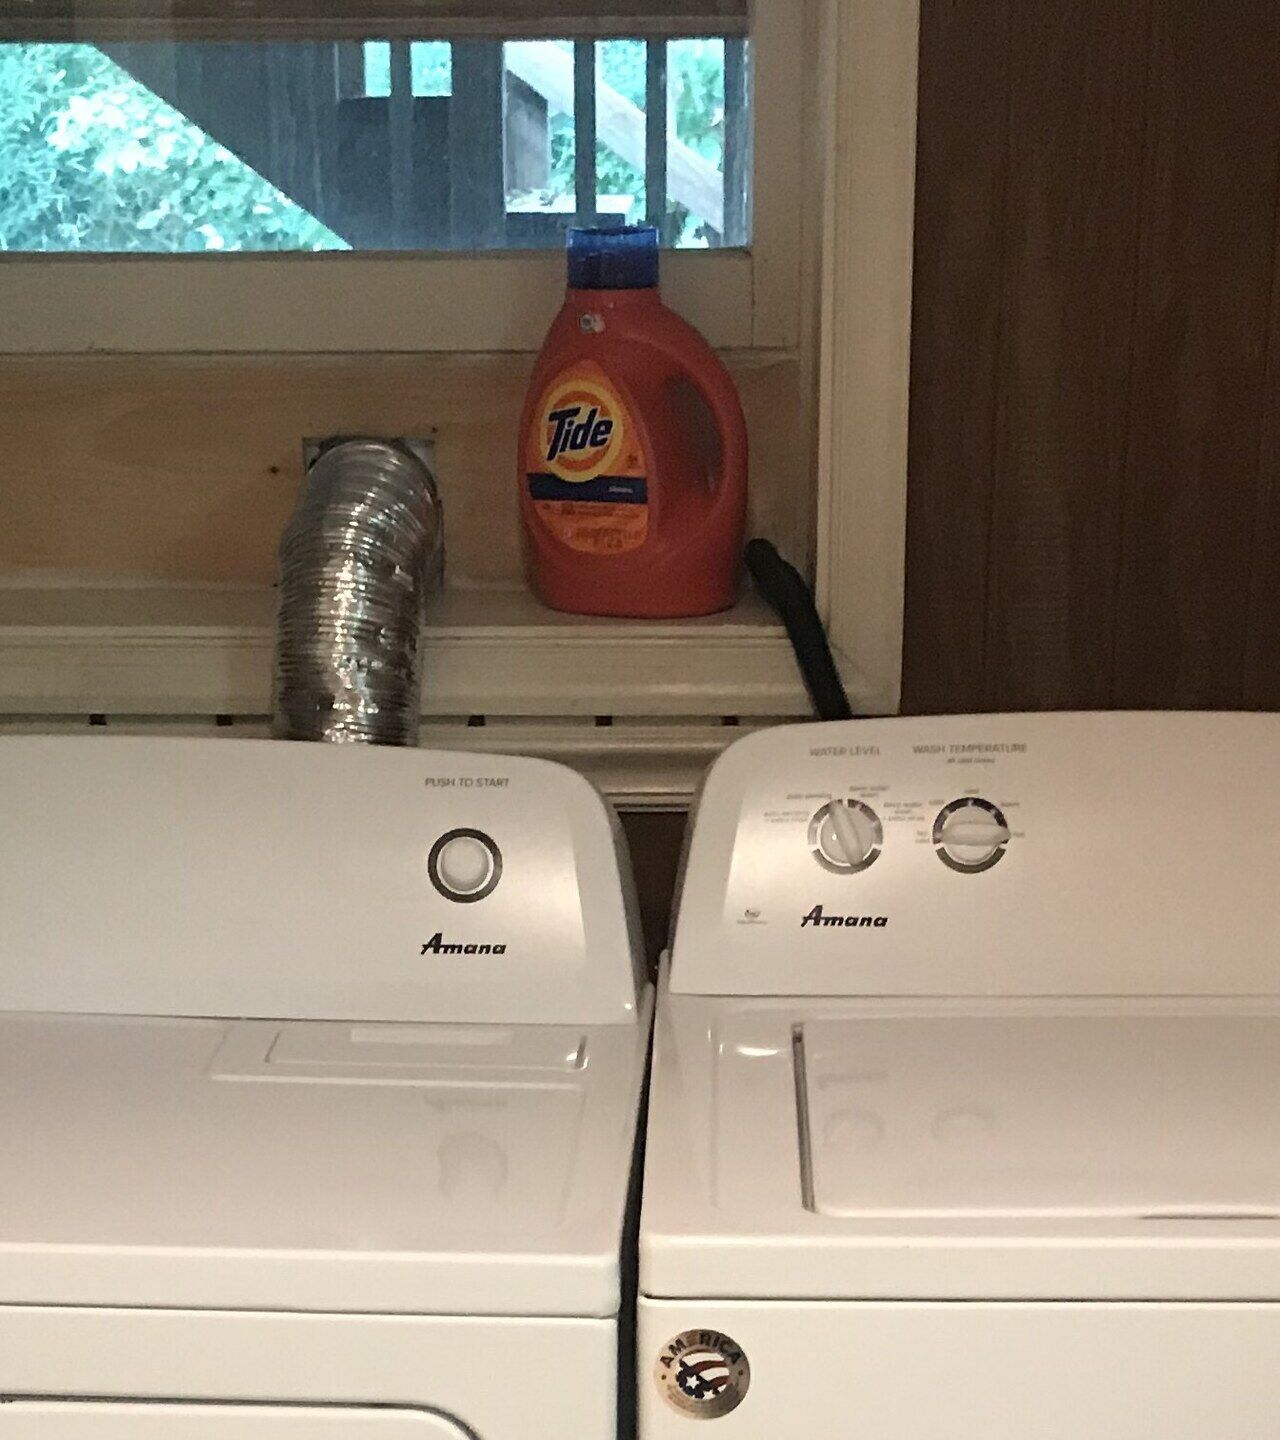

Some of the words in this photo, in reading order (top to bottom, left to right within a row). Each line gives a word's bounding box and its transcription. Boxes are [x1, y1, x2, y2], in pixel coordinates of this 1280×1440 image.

[547, 405, 614, 463] Tide
[809, 746, 847, 757] WATER
[849, 746, 880, 757] LEVEL
[912, 744, 945, 754] WASH
[949, 743, 1028, 754] TEMPERATURE
[424, 777, 456, 788] PUSH
[458, 777, 473, 788] TO
[476, 777, 510, 788] START
[800, 904, 889, 928] Amana
[420, 932, 507, 955] Amana
